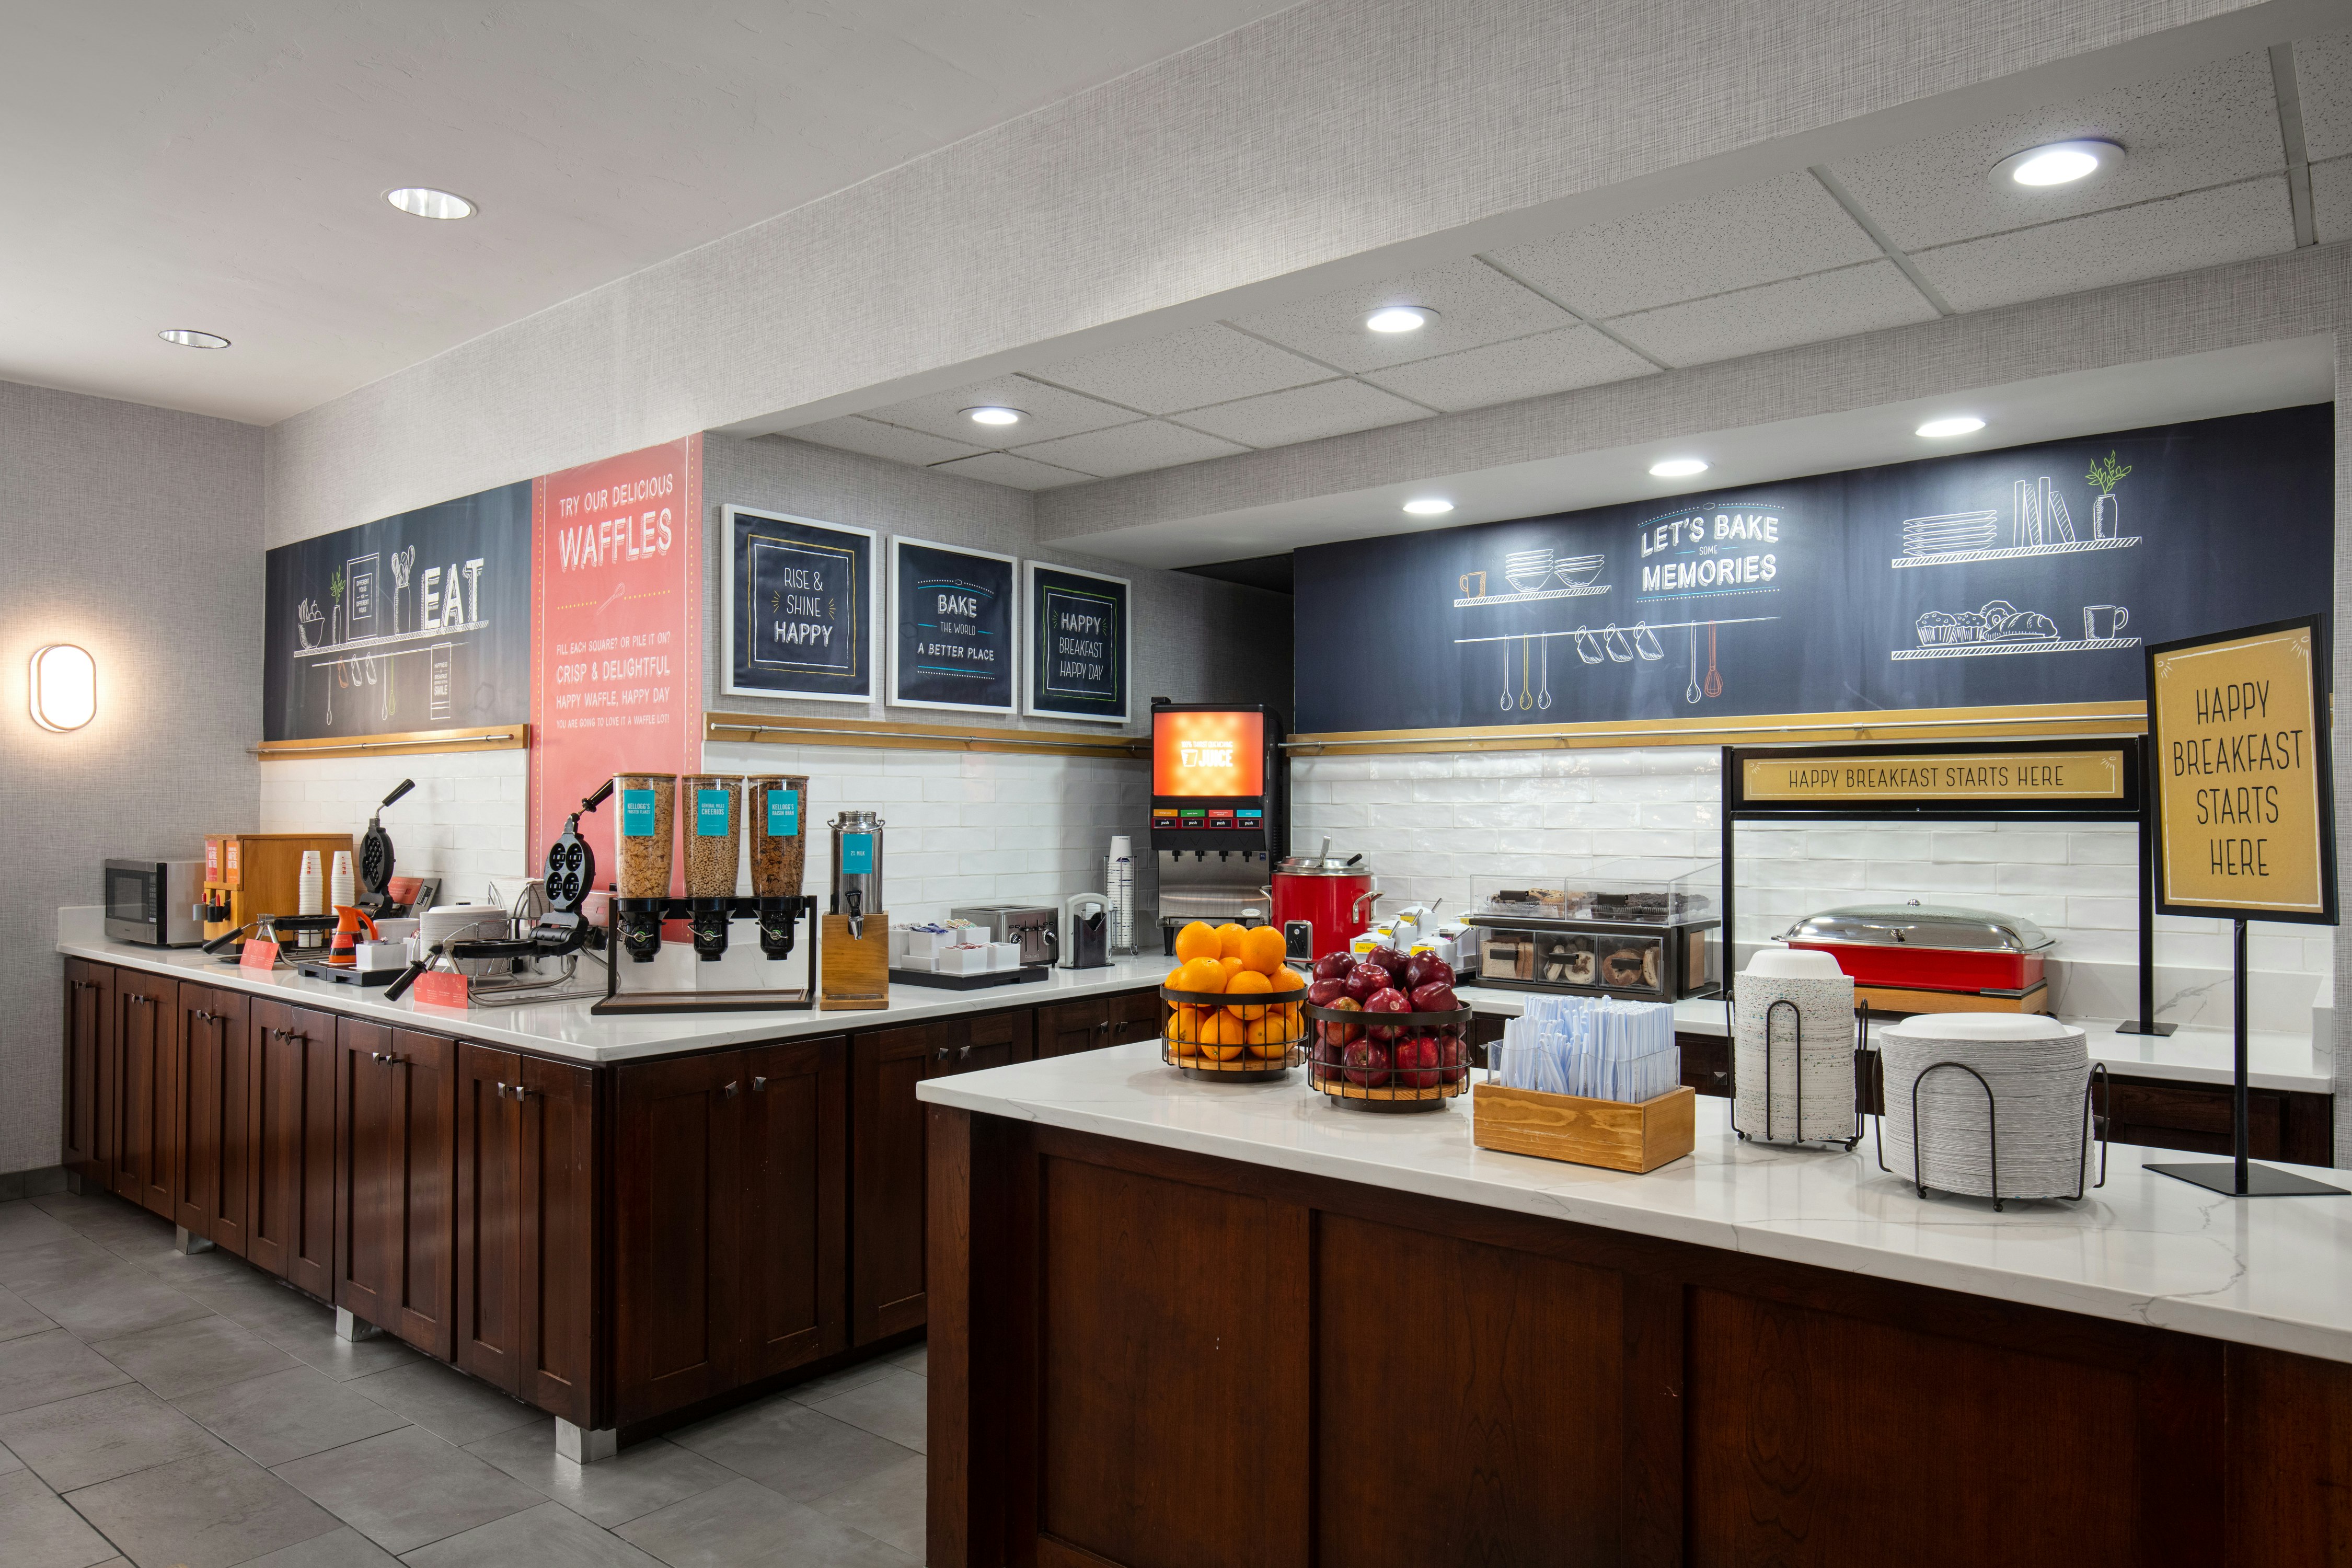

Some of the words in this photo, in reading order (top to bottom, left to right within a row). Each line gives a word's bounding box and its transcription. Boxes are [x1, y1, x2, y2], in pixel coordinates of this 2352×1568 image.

[560, 495, 580, 518] TRY
[584, 489, 607, 514] OUR
[613, 474, 673, 507] DELICIOUS
[559, 508, 672, 573] WAFFLES
[1641, 517, 1704, 558] LET'S
[1714, 514, 1779, 543] BAKE
[1699, 545, 1717, 555] SOME
[785, 568, 810, 590] RISE
[814, 571, 823, 591] &
[1643, 554, 1776, 591] MEMORIES
[421, 558, 484, 631] EAT
[786, 595, 821, 617] SHINE
[938, 594, 976, 617] BAKE
[774, 621, 833, 647] HAPPY
[941, 621, 952, 633] THE
[954, 624, 975, 636] WORLD
[1061, 612, 1101, 635] HAPPY
[557, 644, 568, 655] FILL
[570, 642, 586, 654] EACH
[589, 638, 618, 652] SQUARE?
[620, 637, 629, 648] OR
[633, 635, 646, 647] PILE
[649, 633, 655, 645] IT
[658, 631, 670, 644] ON?
[917, 643, 924, 653] A
[928, 643, 963, 658] BETTER
[967, 647, 994, 661] PLACE
[1059, 637, 1103, 658] BREAKFAST
[557, 663, 587, 685] CRISP
[591, 662, 598, 681] &
[603, 655, 670, 681] DELIGHTFUL
[1060, 661, 1086, 678] HAPPY
[1089, 664, 1103, 681] DAY
[434, 685, 447, 696] SMILE
[557, 694, 581, 709] HAPPY
[584, 691, 618, 708] WAFFLE,
[622, 688, 650, 706] HAPPY
[653, 687, 670, 704] DAY
[2196, 680, 2269, 725] HAPPY
[557, 720, 566, 729] YOU
[568, 719, 578, 728] ARE
[580, 718, 595, 727] GOING
[597, 718, 604, 727] TO
[606, 717, 619, 727] LOVE
[621, 716, 626, 725] IT
[628, 716, 631, 725] A
[634, 714, 655, 724] WAFFLE
[657, 714, 669, 723] LOT!
[1198, 750, 1233, 767] JUICE
[2174, 730, 2302, 776] BREAKFAST
[1789, 769, 1839, 788] HAPPY
[1847, 767, 1939, 788] BREAKFAST
[1946, 766, 2009, 787] STARTS
[2019, 765, 2064, 786] HERE
[2197, 785, 2278, 824] STARTS
[228, 852, 237, 860] WAFFLE
[2210, 838, 2269, 876] HERE
